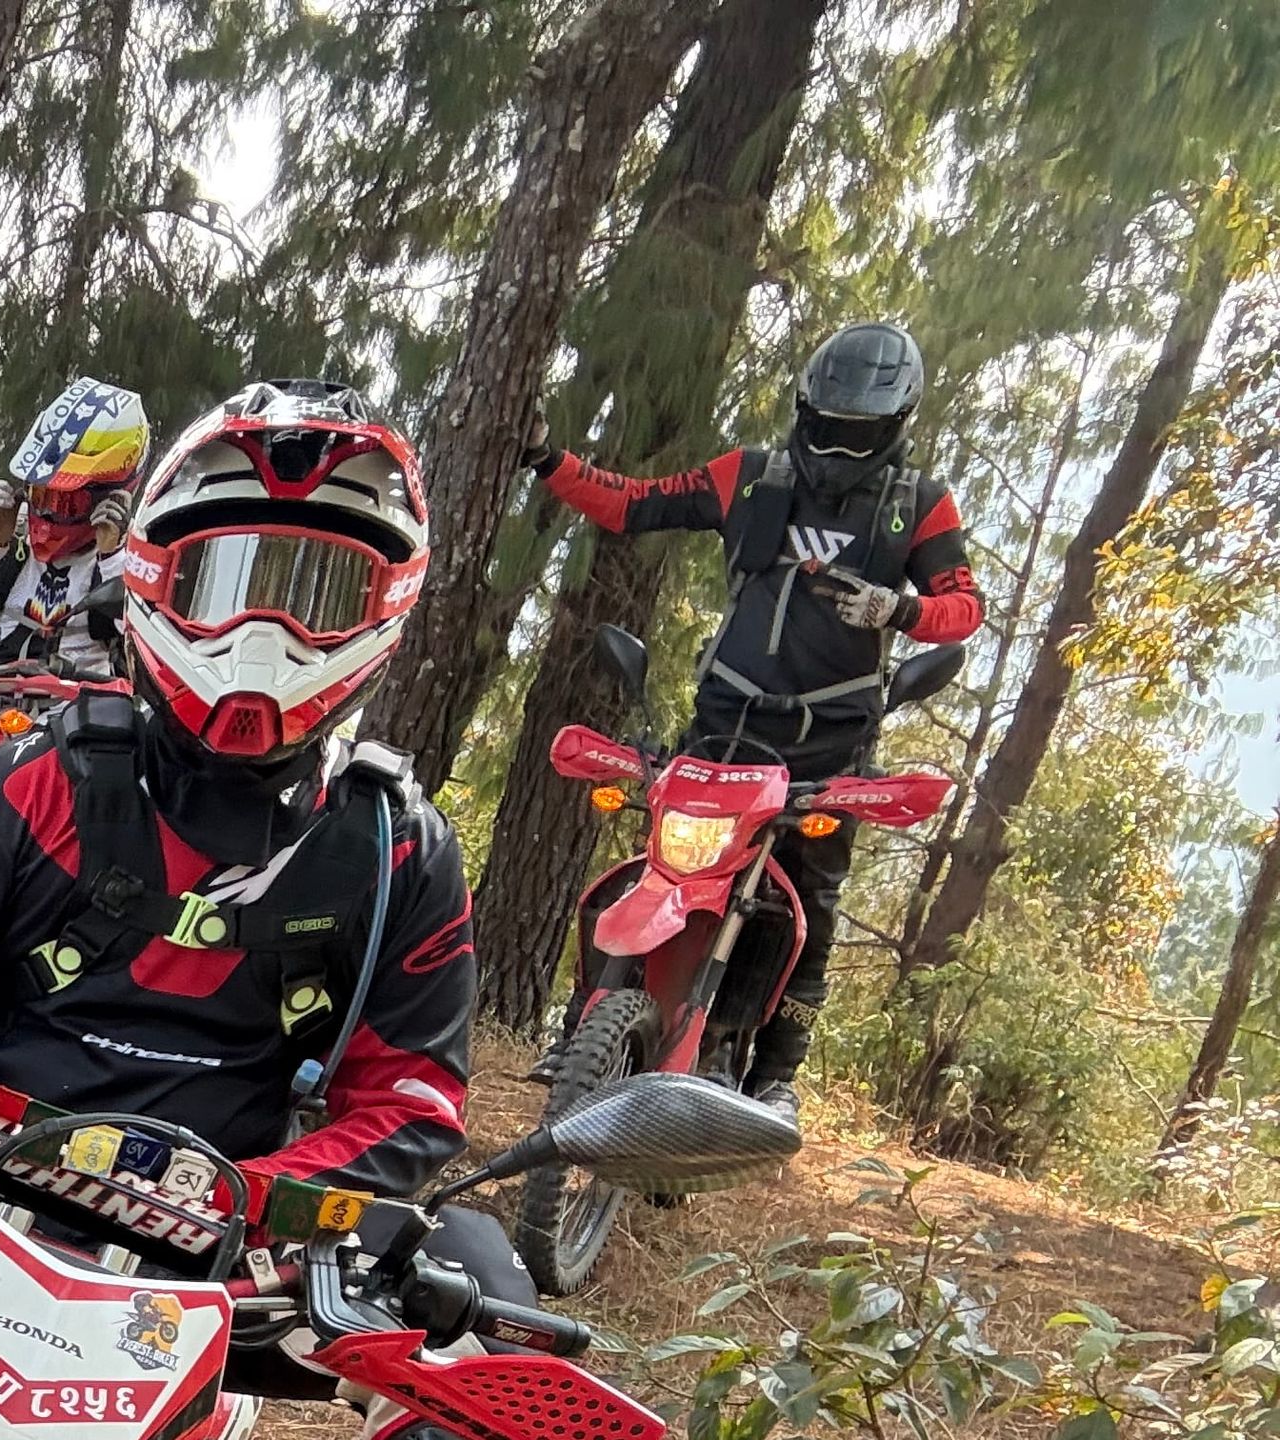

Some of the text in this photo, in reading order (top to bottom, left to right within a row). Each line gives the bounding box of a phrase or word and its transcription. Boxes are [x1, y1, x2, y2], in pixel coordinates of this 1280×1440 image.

[16, 440, 44, 474] FOX
[285, 916, 336, 934] OGIO
[31, 1386, 137, 1420] ८२५६
